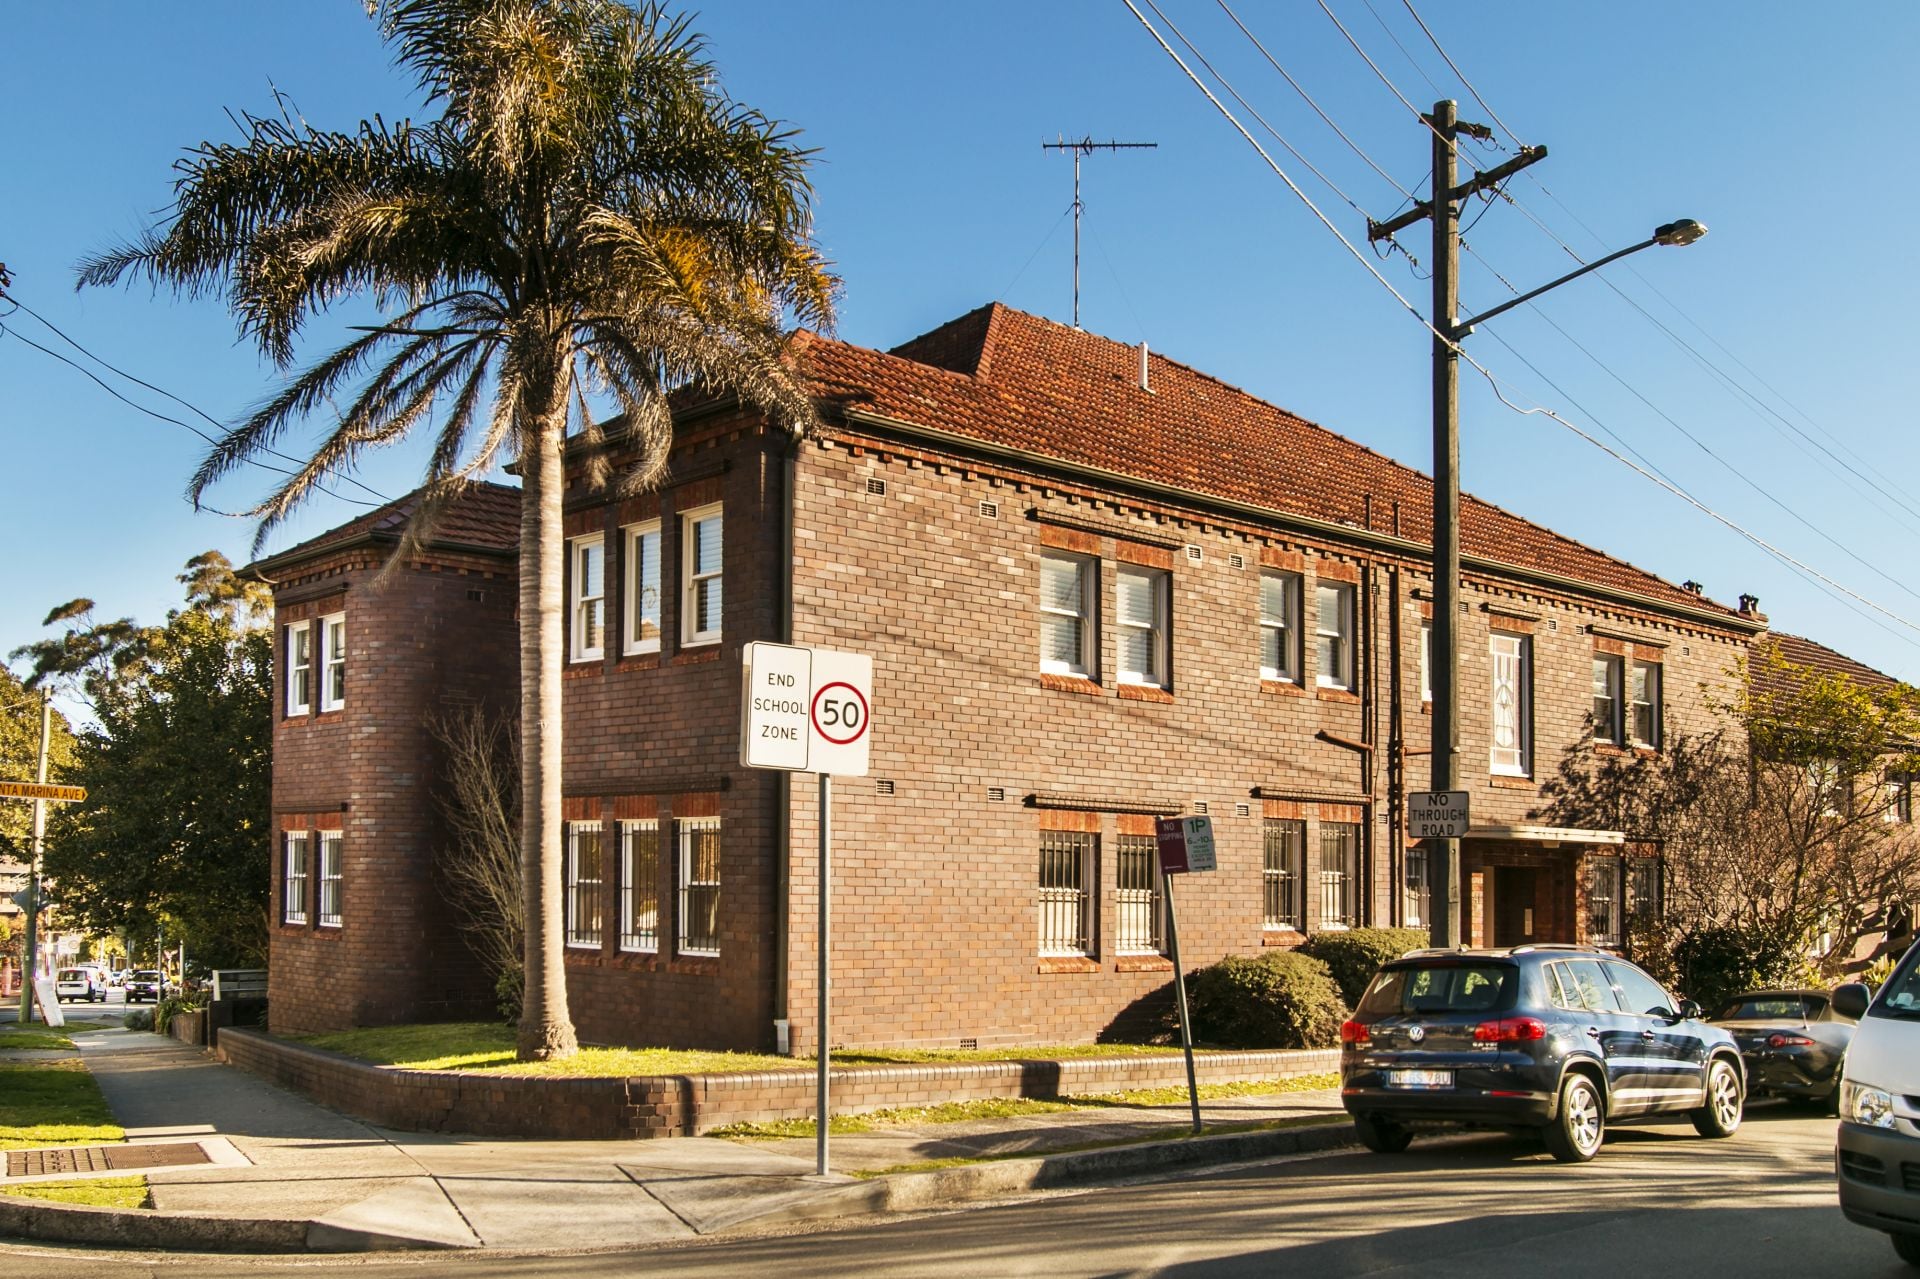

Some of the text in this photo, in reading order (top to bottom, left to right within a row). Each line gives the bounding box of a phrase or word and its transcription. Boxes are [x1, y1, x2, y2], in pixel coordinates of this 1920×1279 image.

[768, 672, 795, 687] END
[754, 697, 807, 715] SCHOOL
[823, 699, 859, 728] 50
[761, 725, 798, 740] ZONE
[22, 785, 59, 798] MARINA
[62, 788, 80, 800] AVE
[1428, 794, 1449, 806] NO
[1411, 809, 1467, 821] THROUGH
[1163, 822, 1175, 831] NO
[1189, 818, 1206, 833] 1P
[1422, 824, 1455, 836] ROAD
